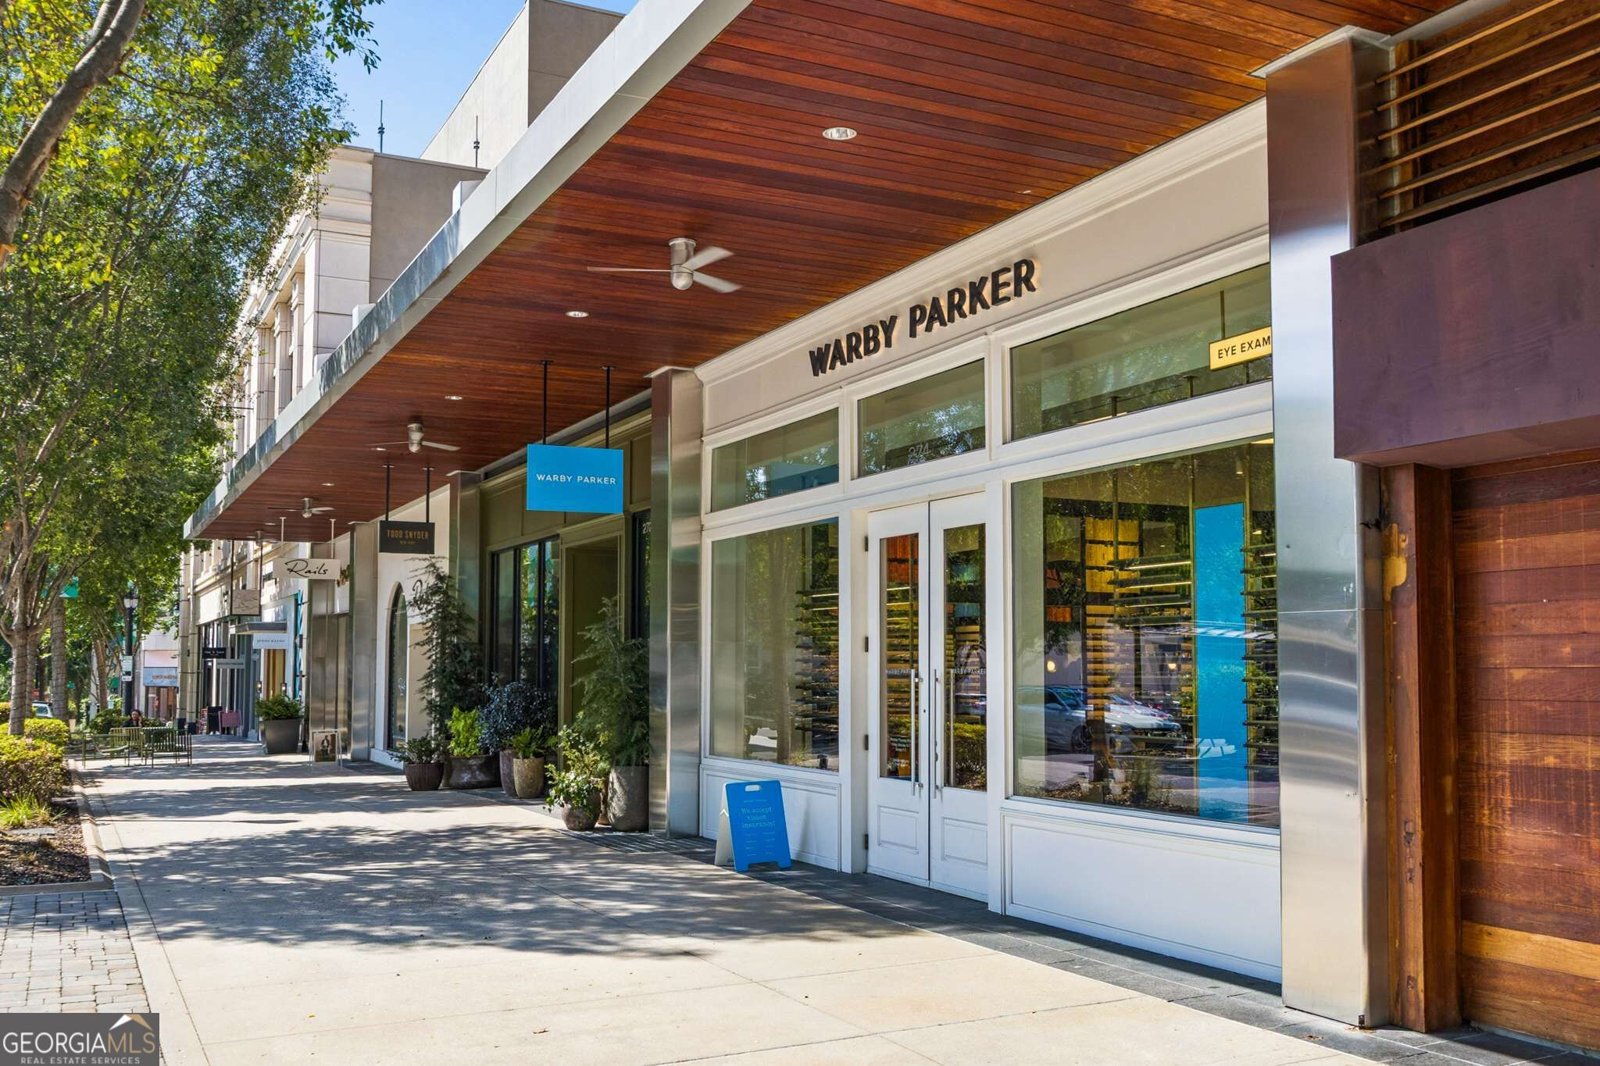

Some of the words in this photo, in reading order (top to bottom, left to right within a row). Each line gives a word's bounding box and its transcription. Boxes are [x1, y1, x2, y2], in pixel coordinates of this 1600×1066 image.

[809, 315, 898, 377] WARBY
[909, 258, 1036, 338] PARKER
[1218, 345, 1237, 359] EYE
[1240, 335, 1271, 353] EXAM
[536, 473, 573, 483] WARBY
[577, 475, 616, 485] PARKER
[387, 529, 403, 539] TODD
[404, 530, 429, 540] SNYDER
[284, 558, 328, 577] Rails
